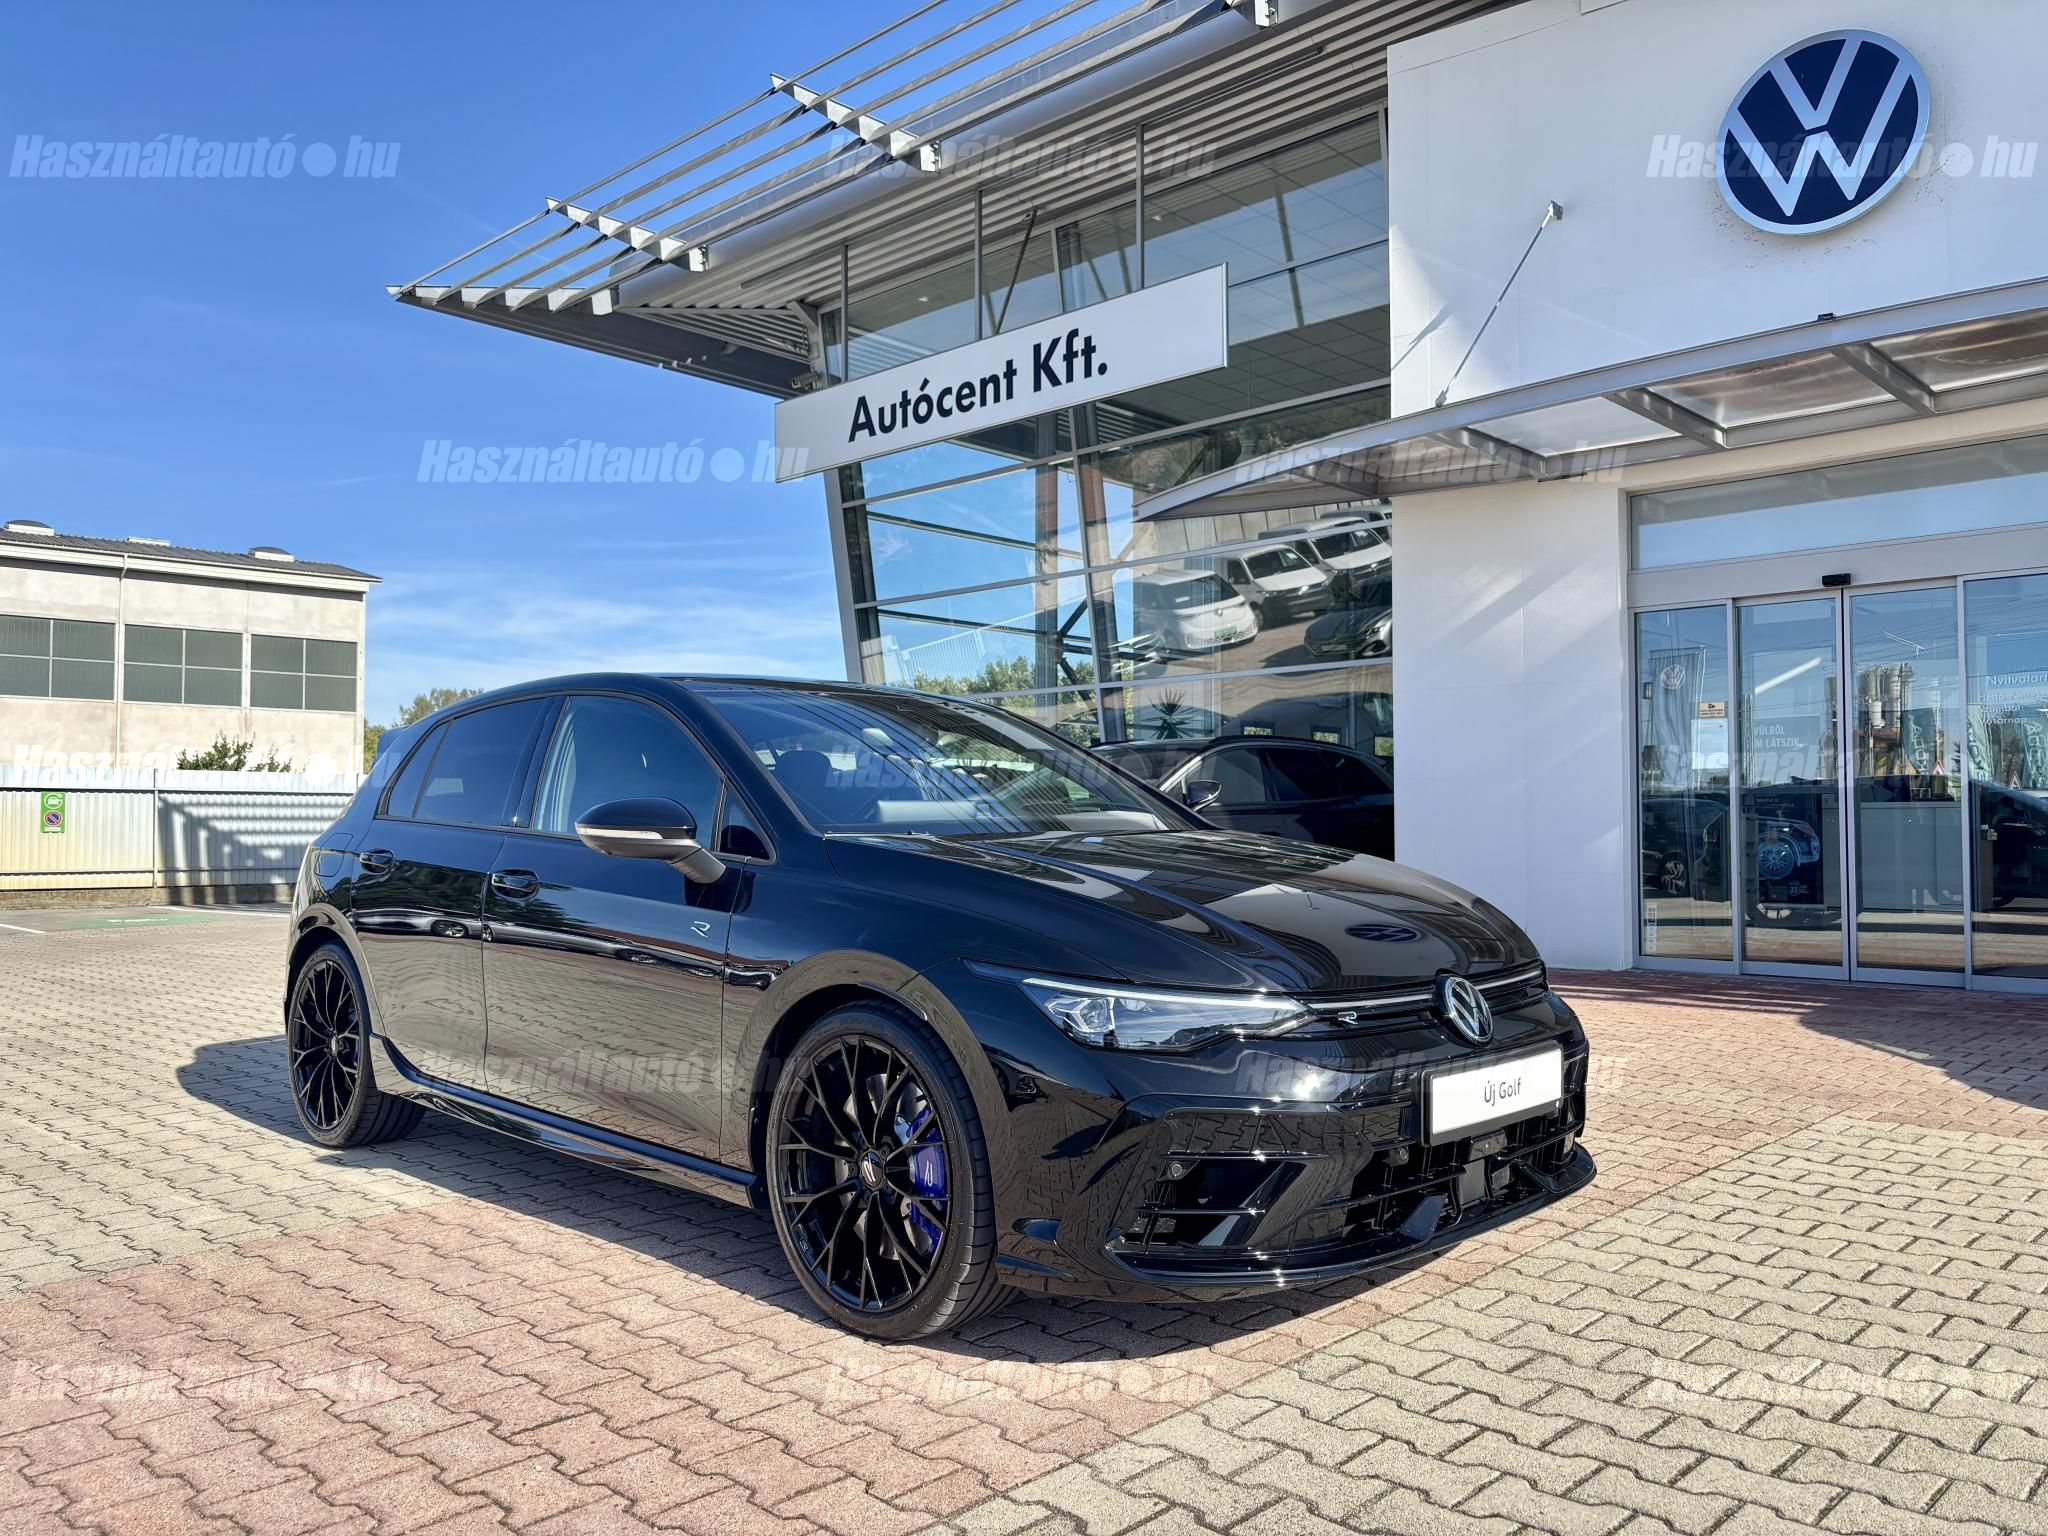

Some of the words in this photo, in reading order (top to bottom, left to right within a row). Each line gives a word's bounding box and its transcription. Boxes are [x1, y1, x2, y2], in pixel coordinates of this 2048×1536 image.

[848, 358, 1017, 442] Autócent
[1033, 327, 1108, 392] Kft.
[1484, 1080, 1496, 1106] Új
[1499, 1077, 1521, 1099] Golf
